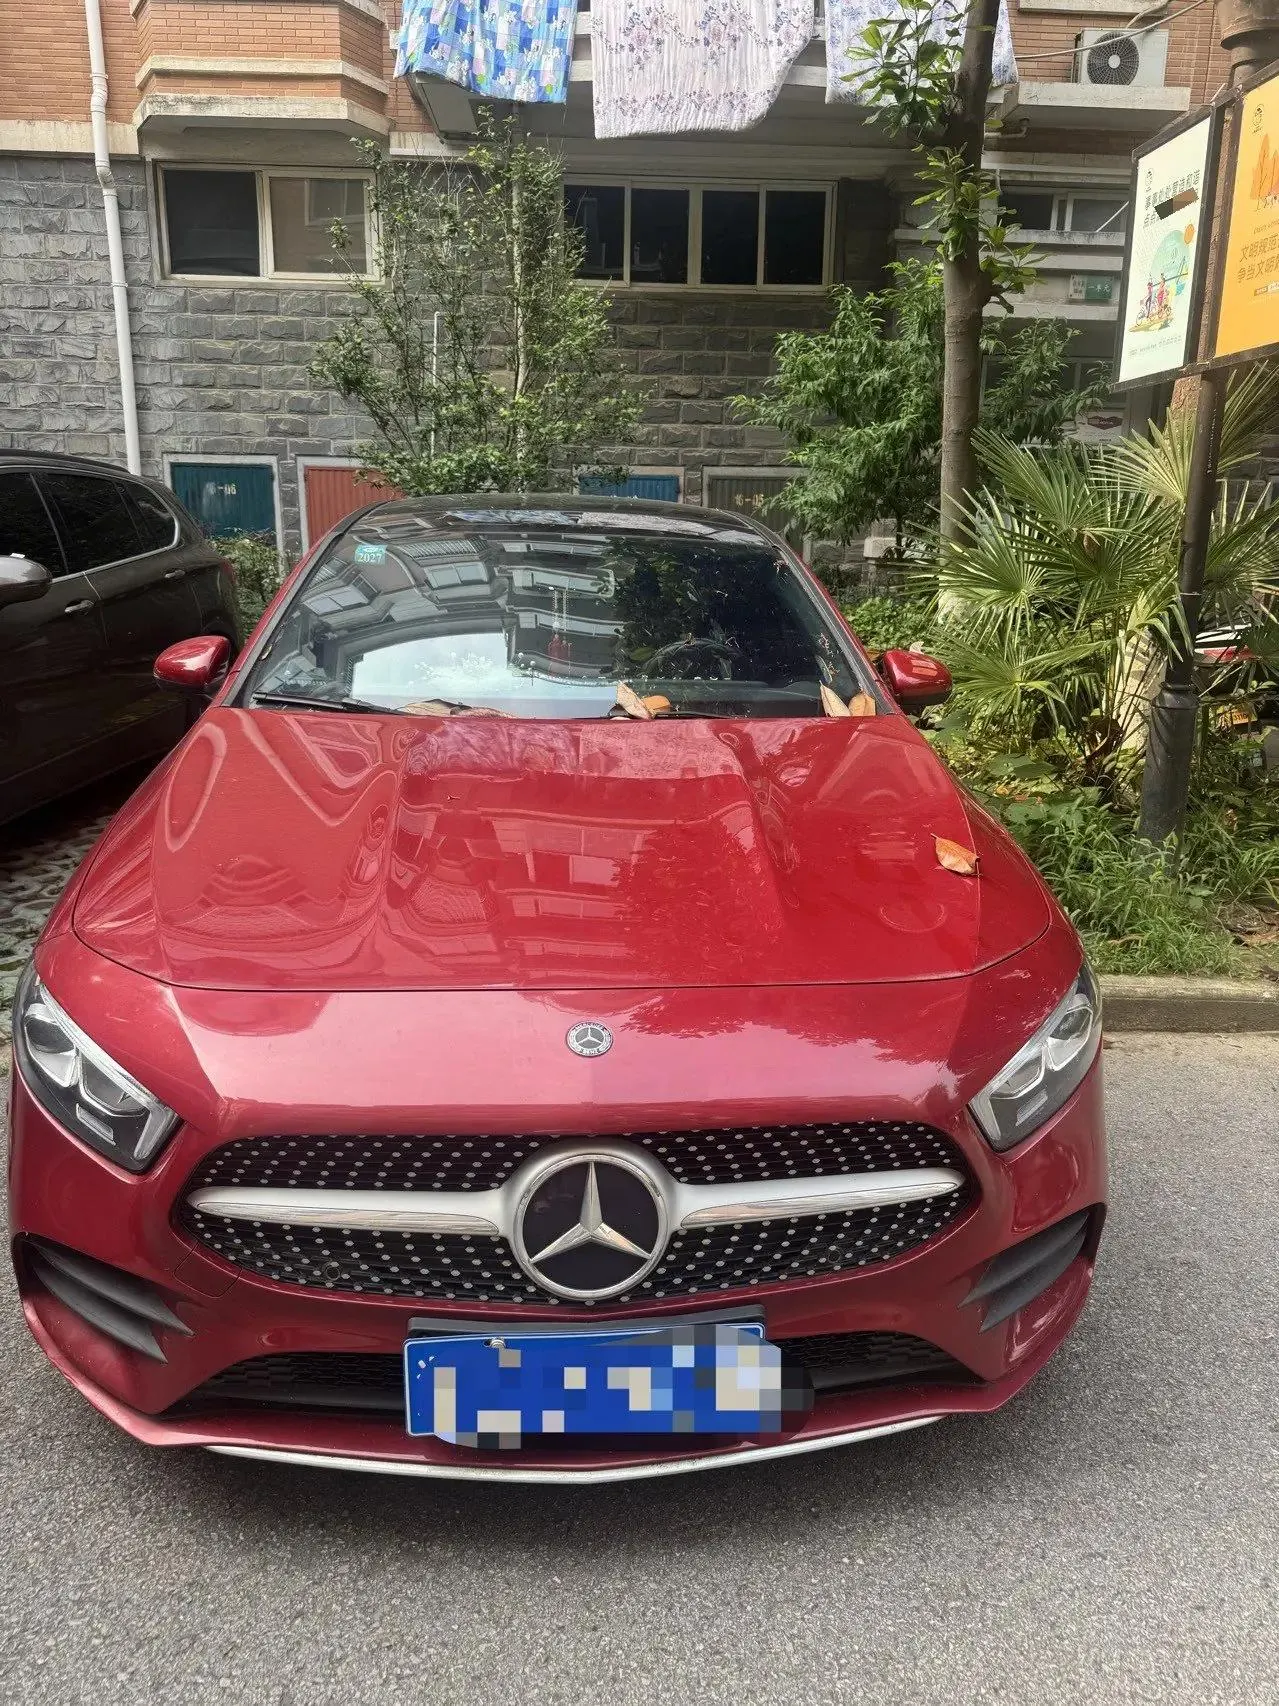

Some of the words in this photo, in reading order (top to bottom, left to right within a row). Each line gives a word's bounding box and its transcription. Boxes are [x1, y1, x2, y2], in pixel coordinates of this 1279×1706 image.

[1240, 233, 1279, 262] 文明规范
[357, 552, 383, 565] 2027
